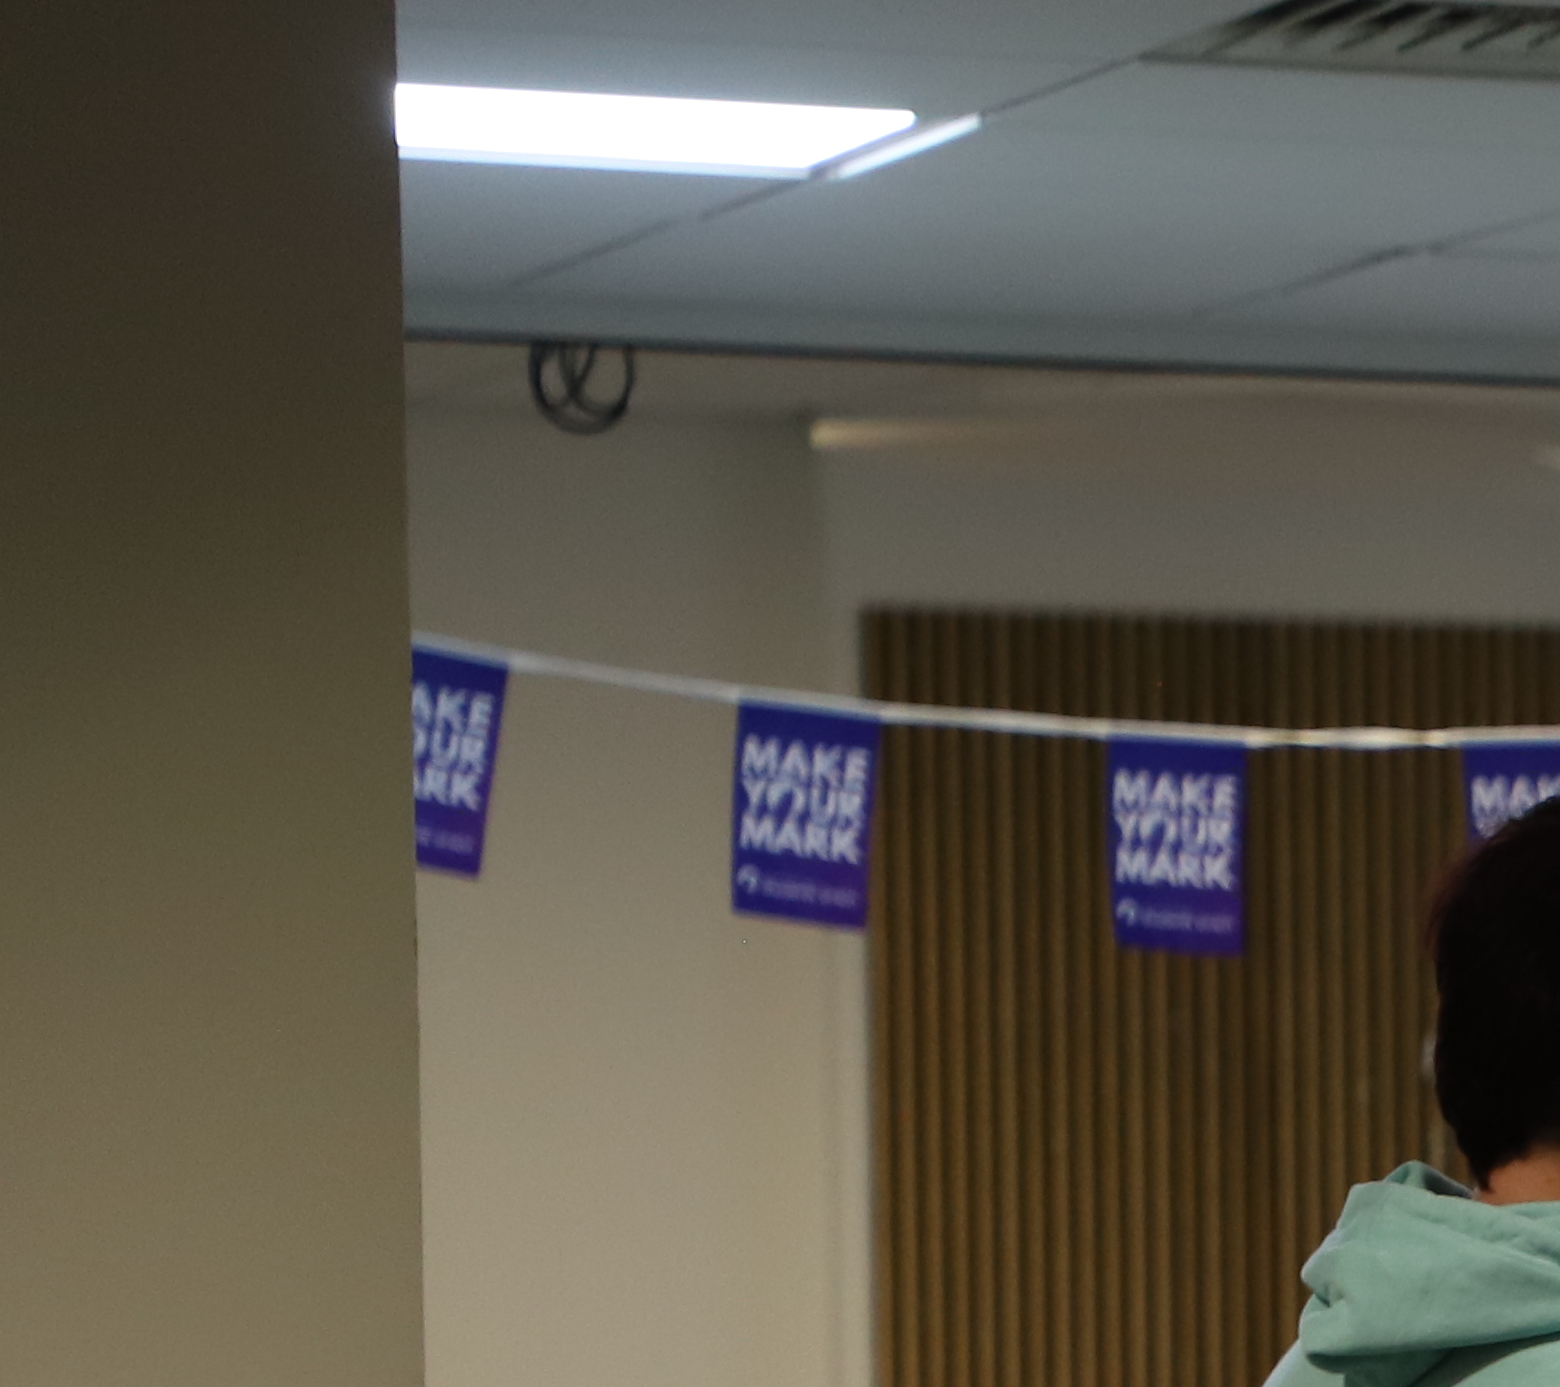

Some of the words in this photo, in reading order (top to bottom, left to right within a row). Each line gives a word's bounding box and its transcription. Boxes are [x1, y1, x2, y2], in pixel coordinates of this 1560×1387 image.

[412, 680, 495, 729] AKE
[742, 733, 872, 785] MAKE
[743, 778, 869, 828] YOUR
[1112, 767, 1239, 812] MAKE
[738, 816, 862, 865] MARK
[1114, 809, 1237, 856] YOUR
[1114, 848, 1237, 892] MARK
